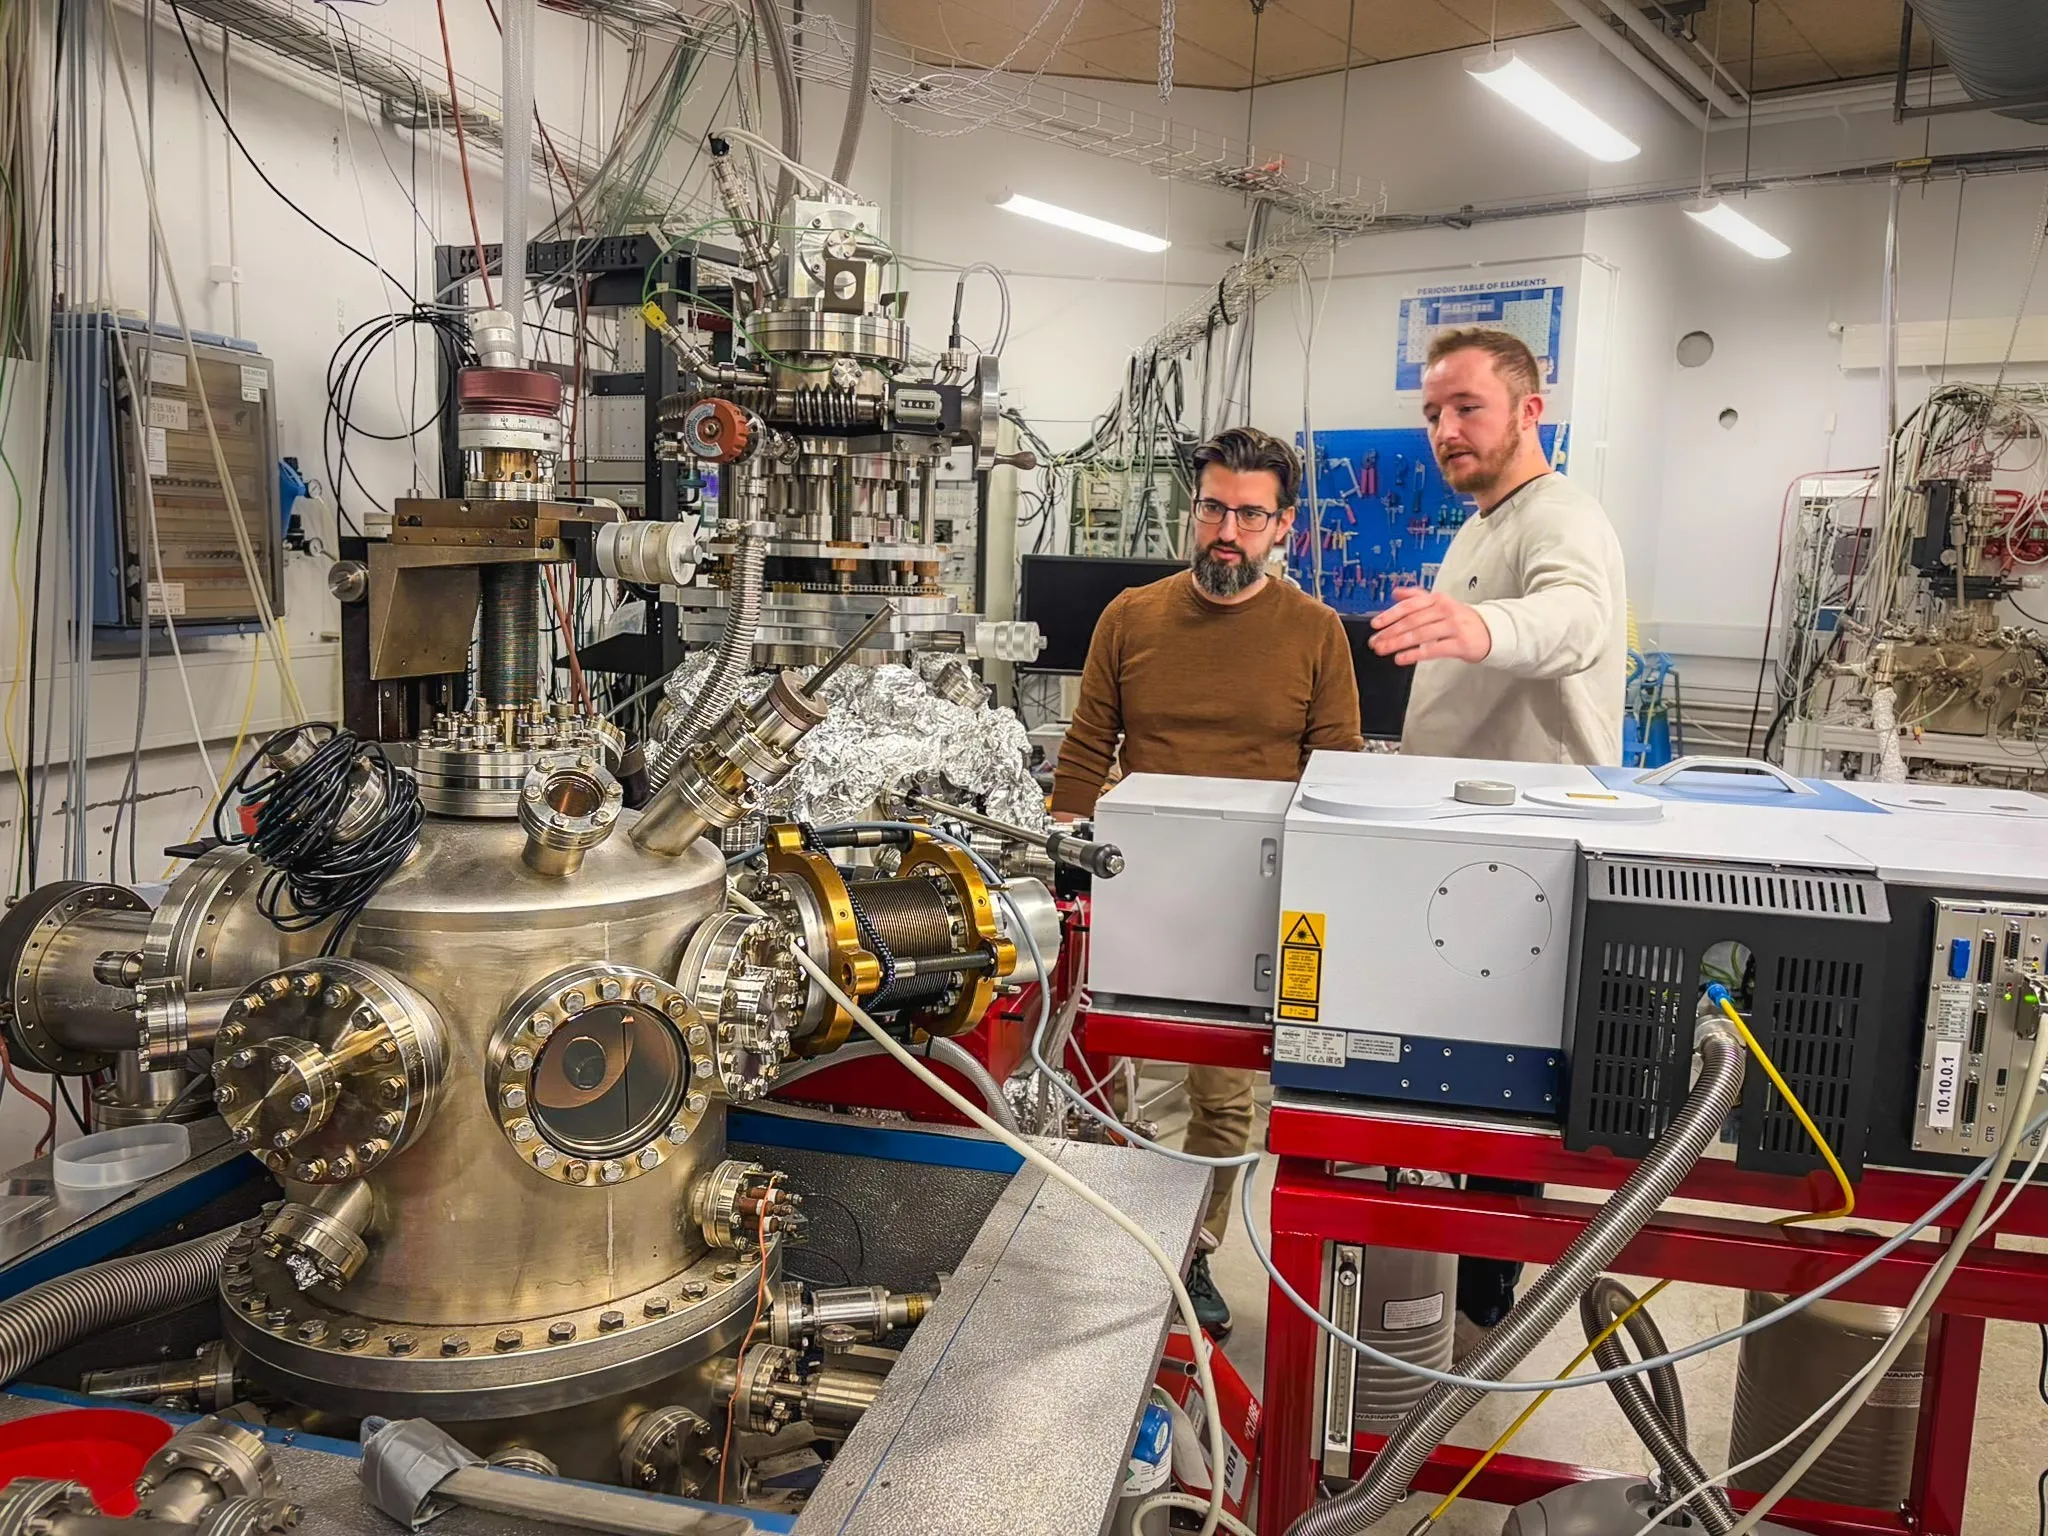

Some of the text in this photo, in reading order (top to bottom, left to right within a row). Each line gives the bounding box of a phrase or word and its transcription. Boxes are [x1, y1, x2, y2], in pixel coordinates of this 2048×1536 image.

[1417, 278, 1547, 295] PERIODIC TABLE OF ELEMENTS
[1937, 1057, 1955, 1115] 10.10.0.1
[1985, 1126, 1996, 1142] CTR
